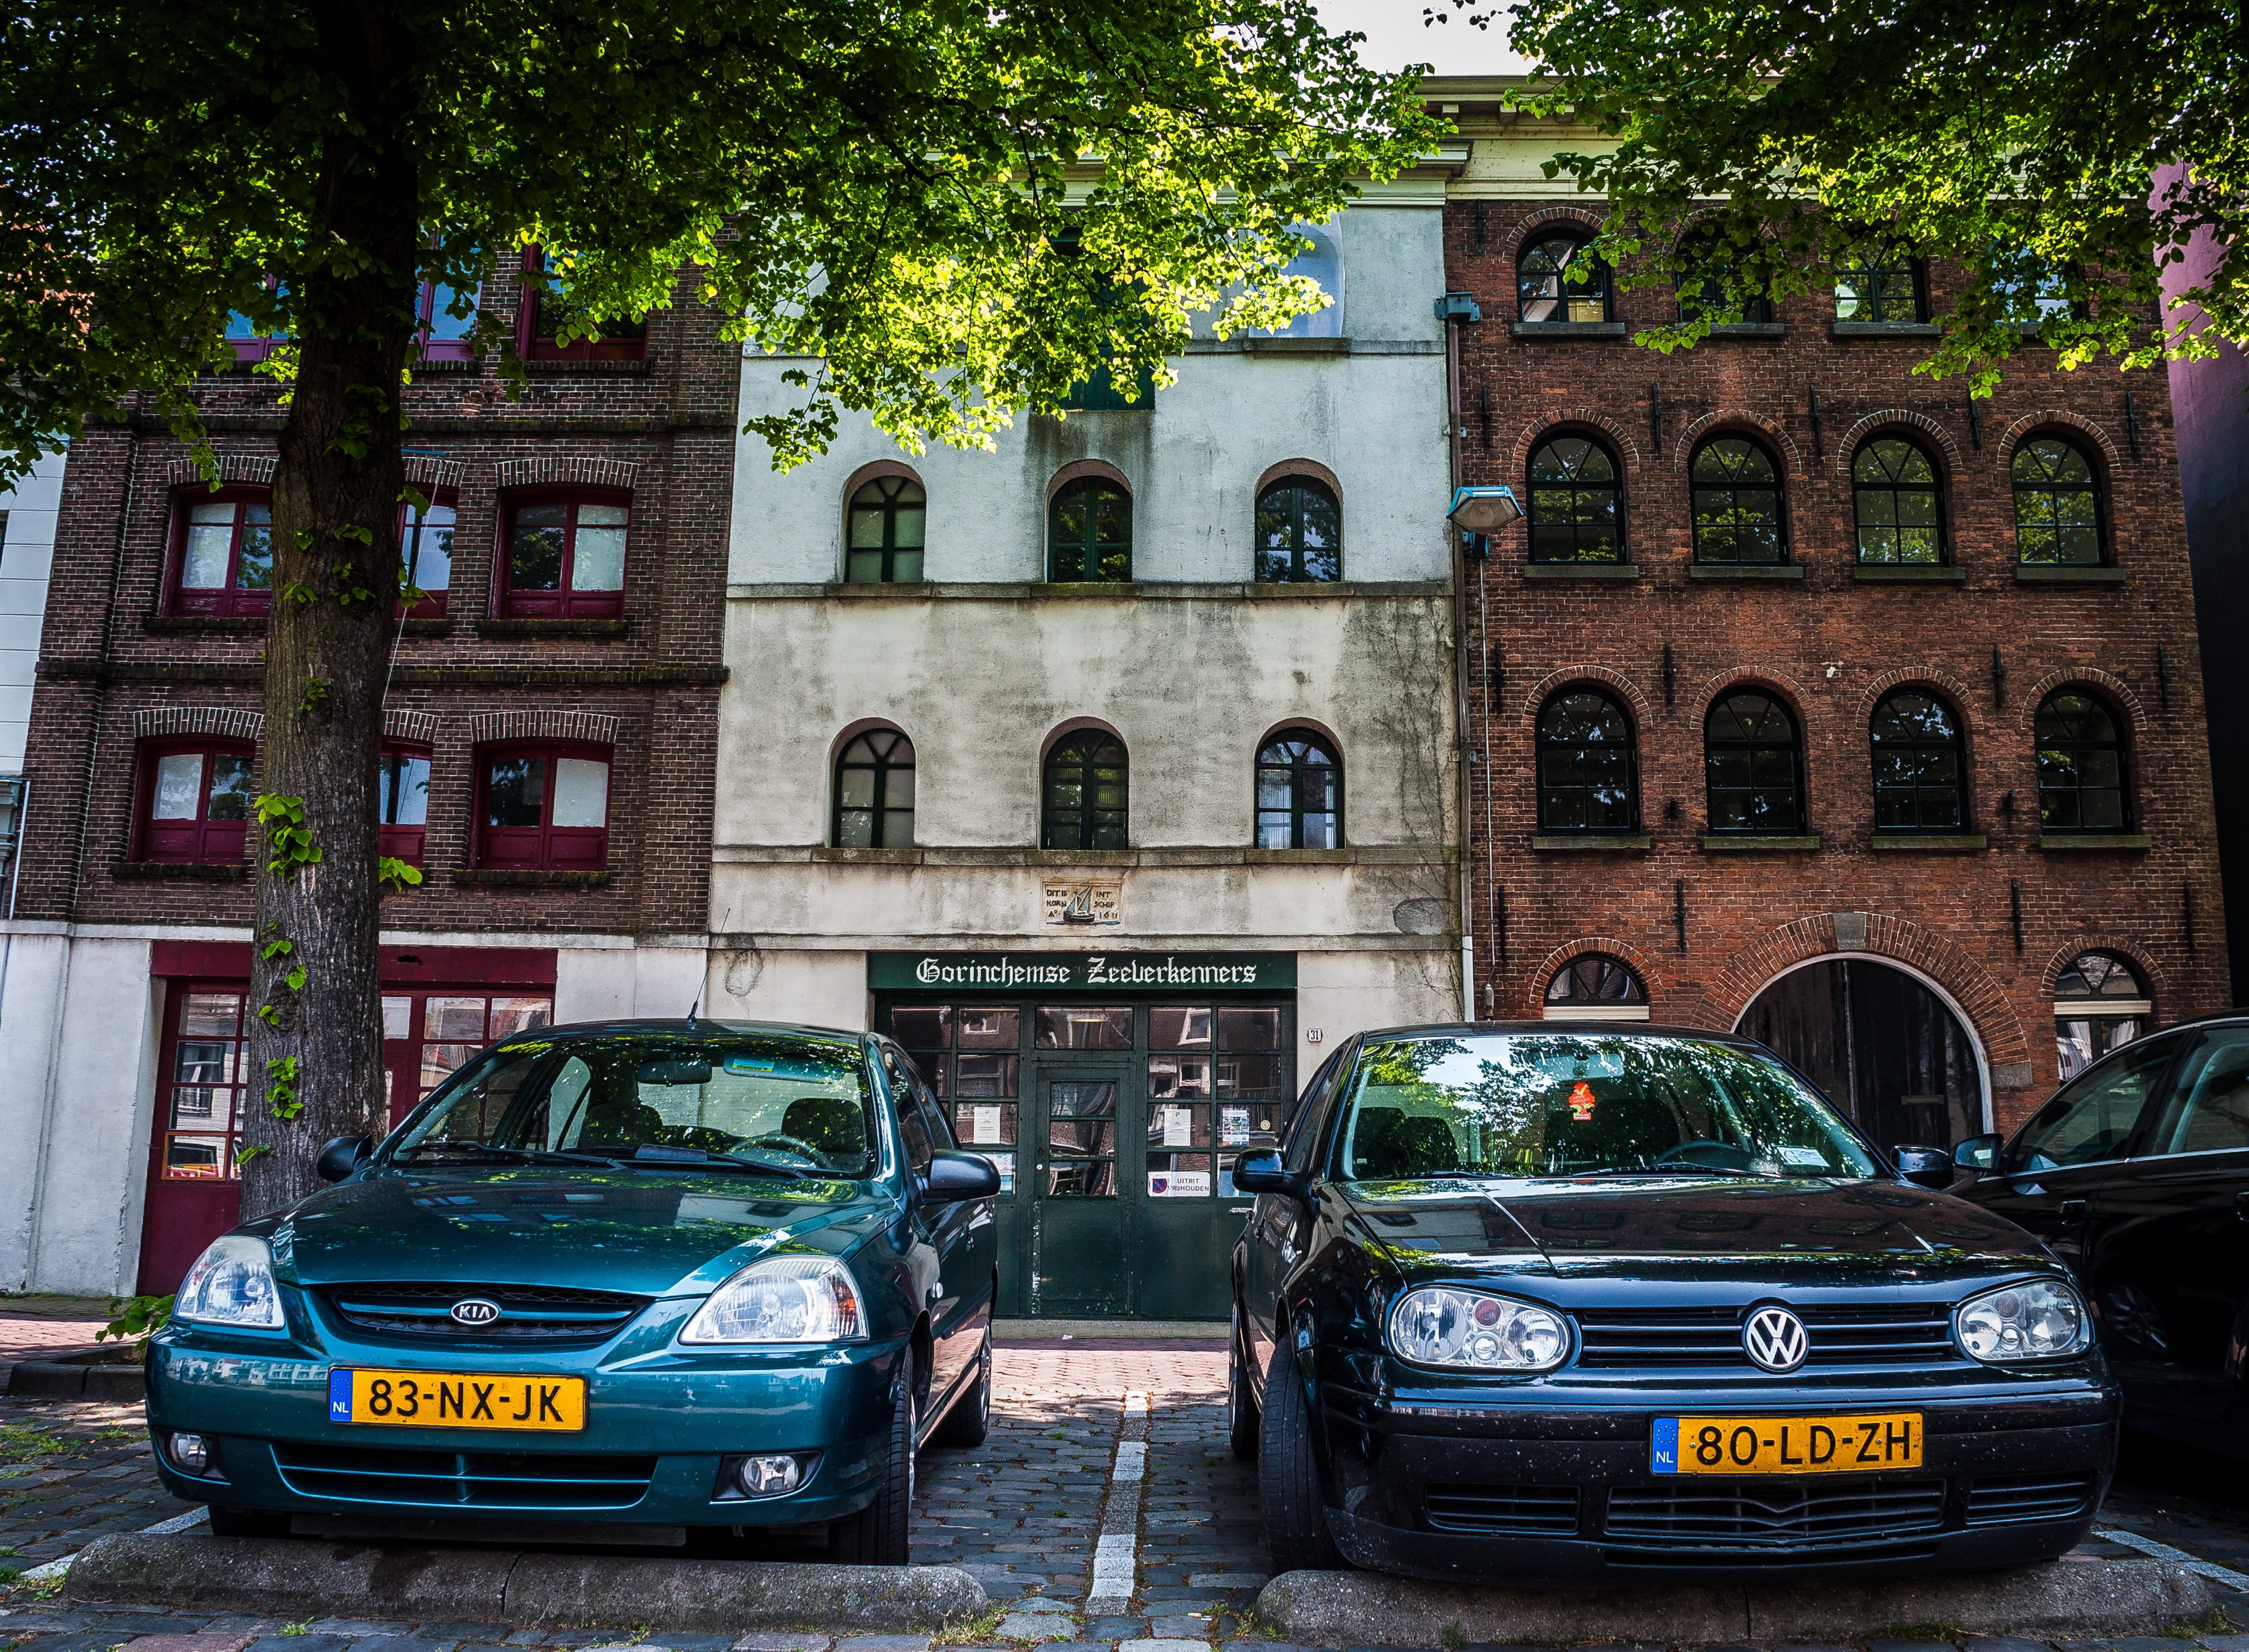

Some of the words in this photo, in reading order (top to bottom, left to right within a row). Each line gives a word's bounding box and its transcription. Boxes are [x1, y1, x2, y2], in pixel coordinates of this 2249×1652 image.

[917, 956, 1071, 988] Gorinchemse
[1087, 957, 1256, 983] Zeeverkenners
[1311, 1029, 1319, 1040] 31
[459, 1305, 490, 1318] KIA
[333, 1402, 349, 1413] NL
[369, 1379, 564, 1423] 83-NX-JK
[1696, 1420, 1911, 1466] 80-LD-ZH
[1655, 1451, 1674, 1463] NL
